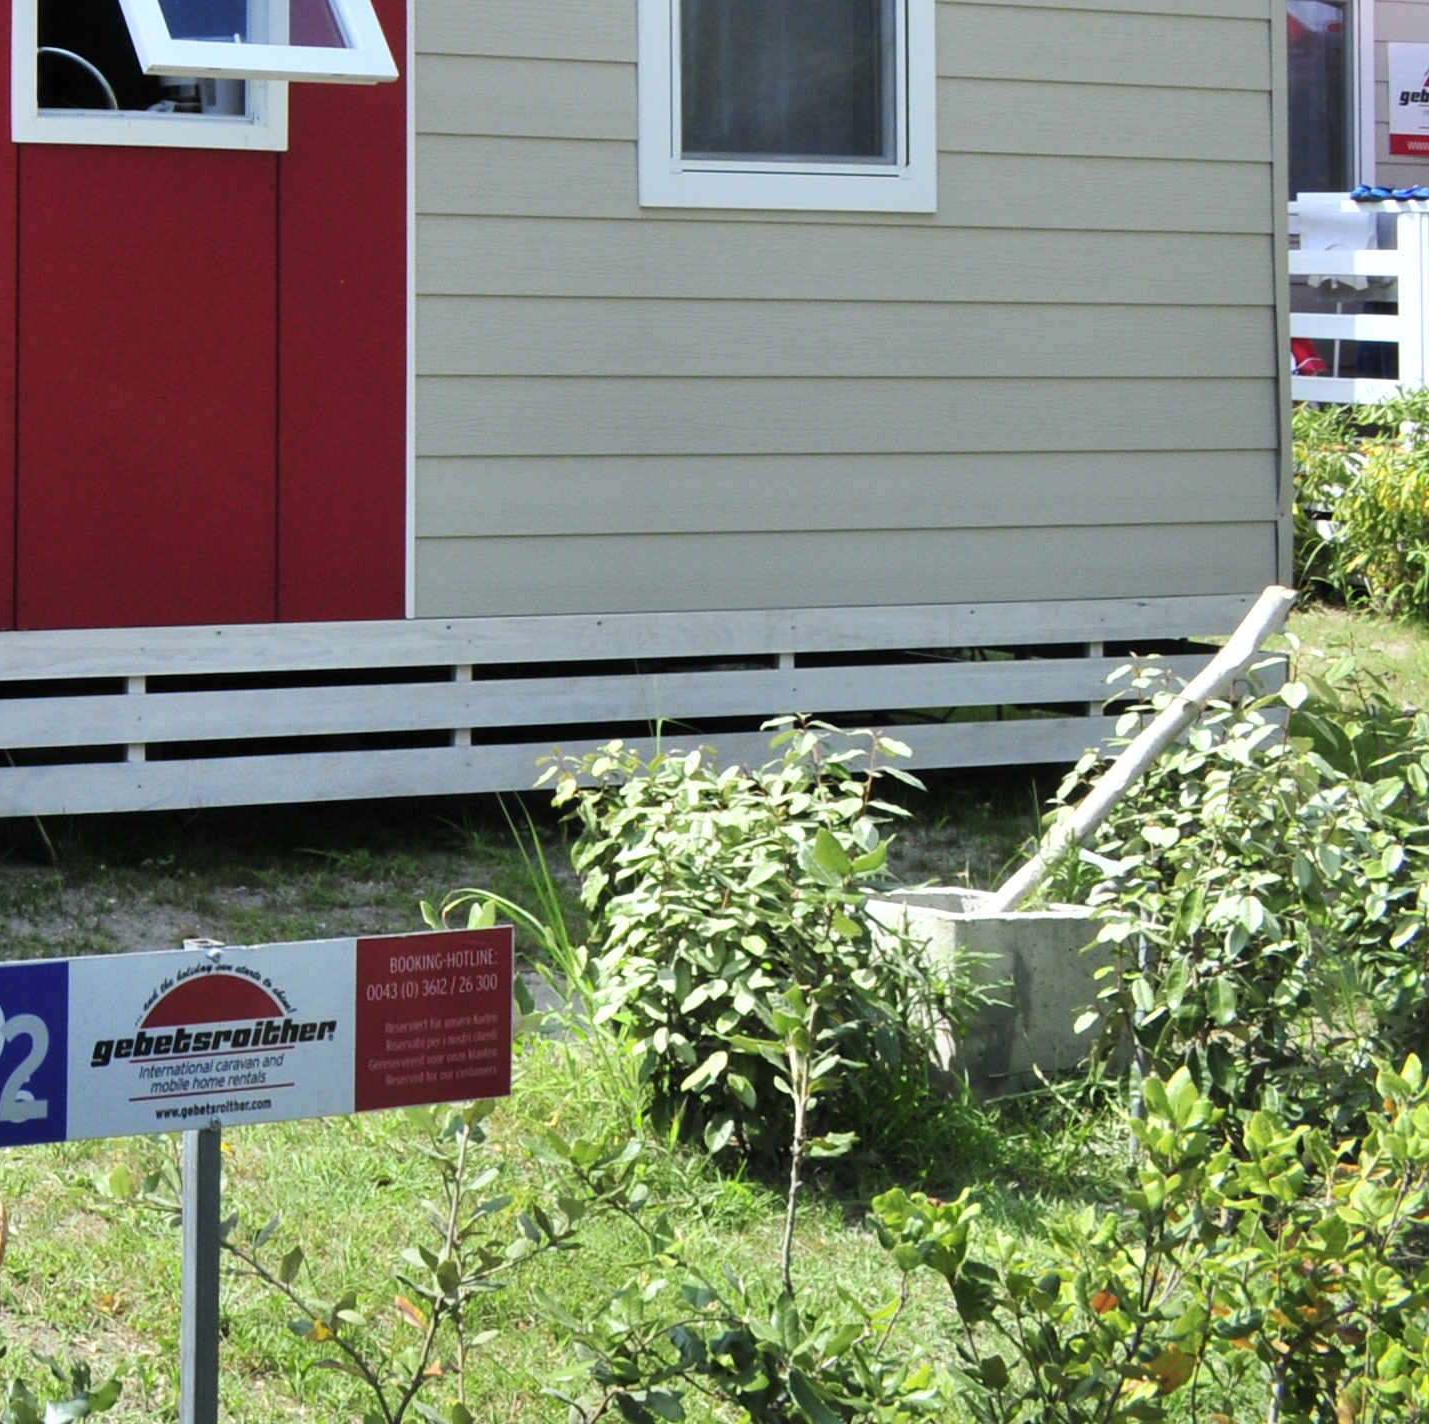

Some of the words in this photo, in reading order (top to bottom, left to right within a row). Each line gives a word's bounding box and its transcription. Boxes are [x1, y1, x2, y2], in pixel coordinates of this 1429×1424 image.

[390, 948, 498, 974] BOOKING-HOTLINE:
[366, 982, 398, 1002] 0043
[401, 981, 419, 1000] (0)
[422, 978, 448, 997] 3612
[459, 976, 473, 993] 26
[476, 974, 498, 991] 300
[91, 1019, 337, 1067] gebetsroither
[139, 1059, 214, 1079] International
[215, 1057, 260, 1073] caravan
[262, 1053, 285, 1068] and
[150, 1077, 190, 1094] mobile
[192, 1075, 226, 1090] home
[227, 1070, 267, 1087] rentals
[155, 1098, 272, 1120] www.gebetsroither.com
